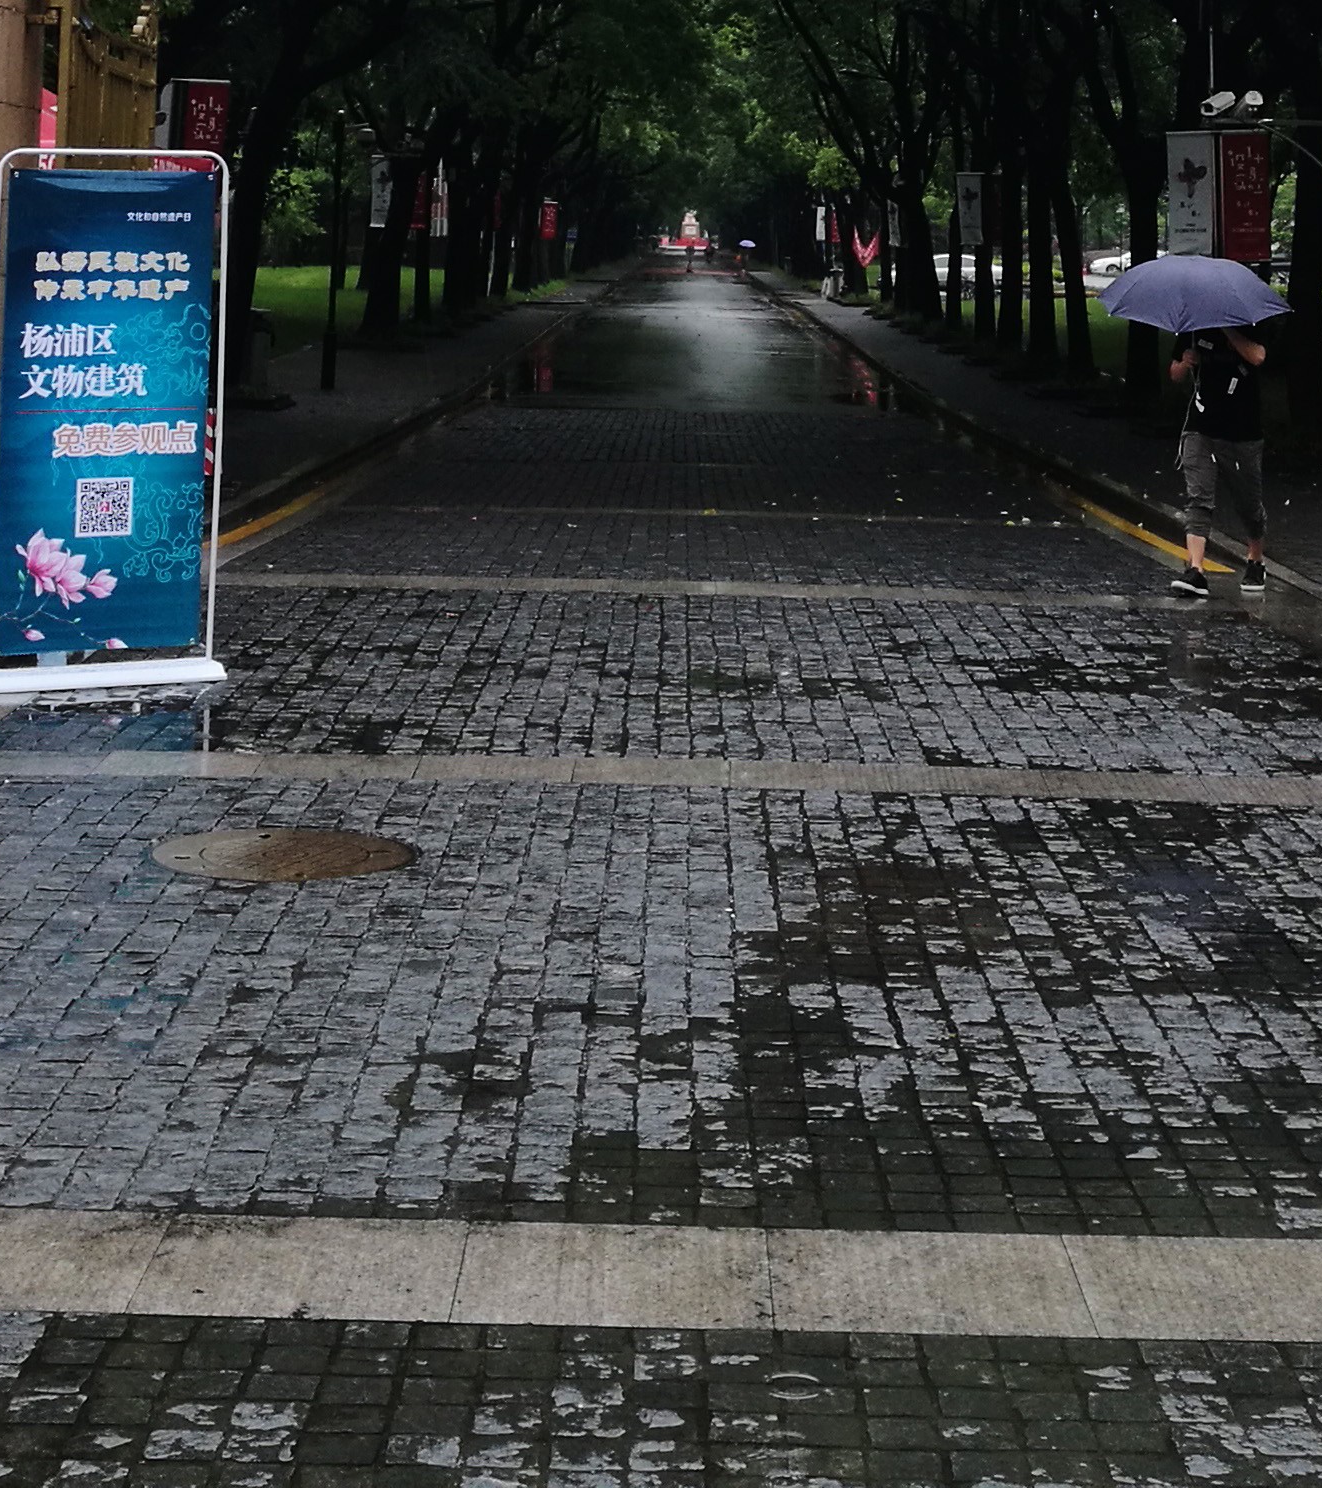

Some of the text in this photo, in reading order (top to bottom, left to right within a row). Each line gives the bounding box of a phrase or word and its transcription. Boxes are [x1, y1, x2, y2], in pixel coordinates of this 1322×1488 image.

[20, 322, 117, 359] 杨浦区
[18, 363, 148, 400] 文物建筑
[52, 420, 198, 458] 免费参观点
